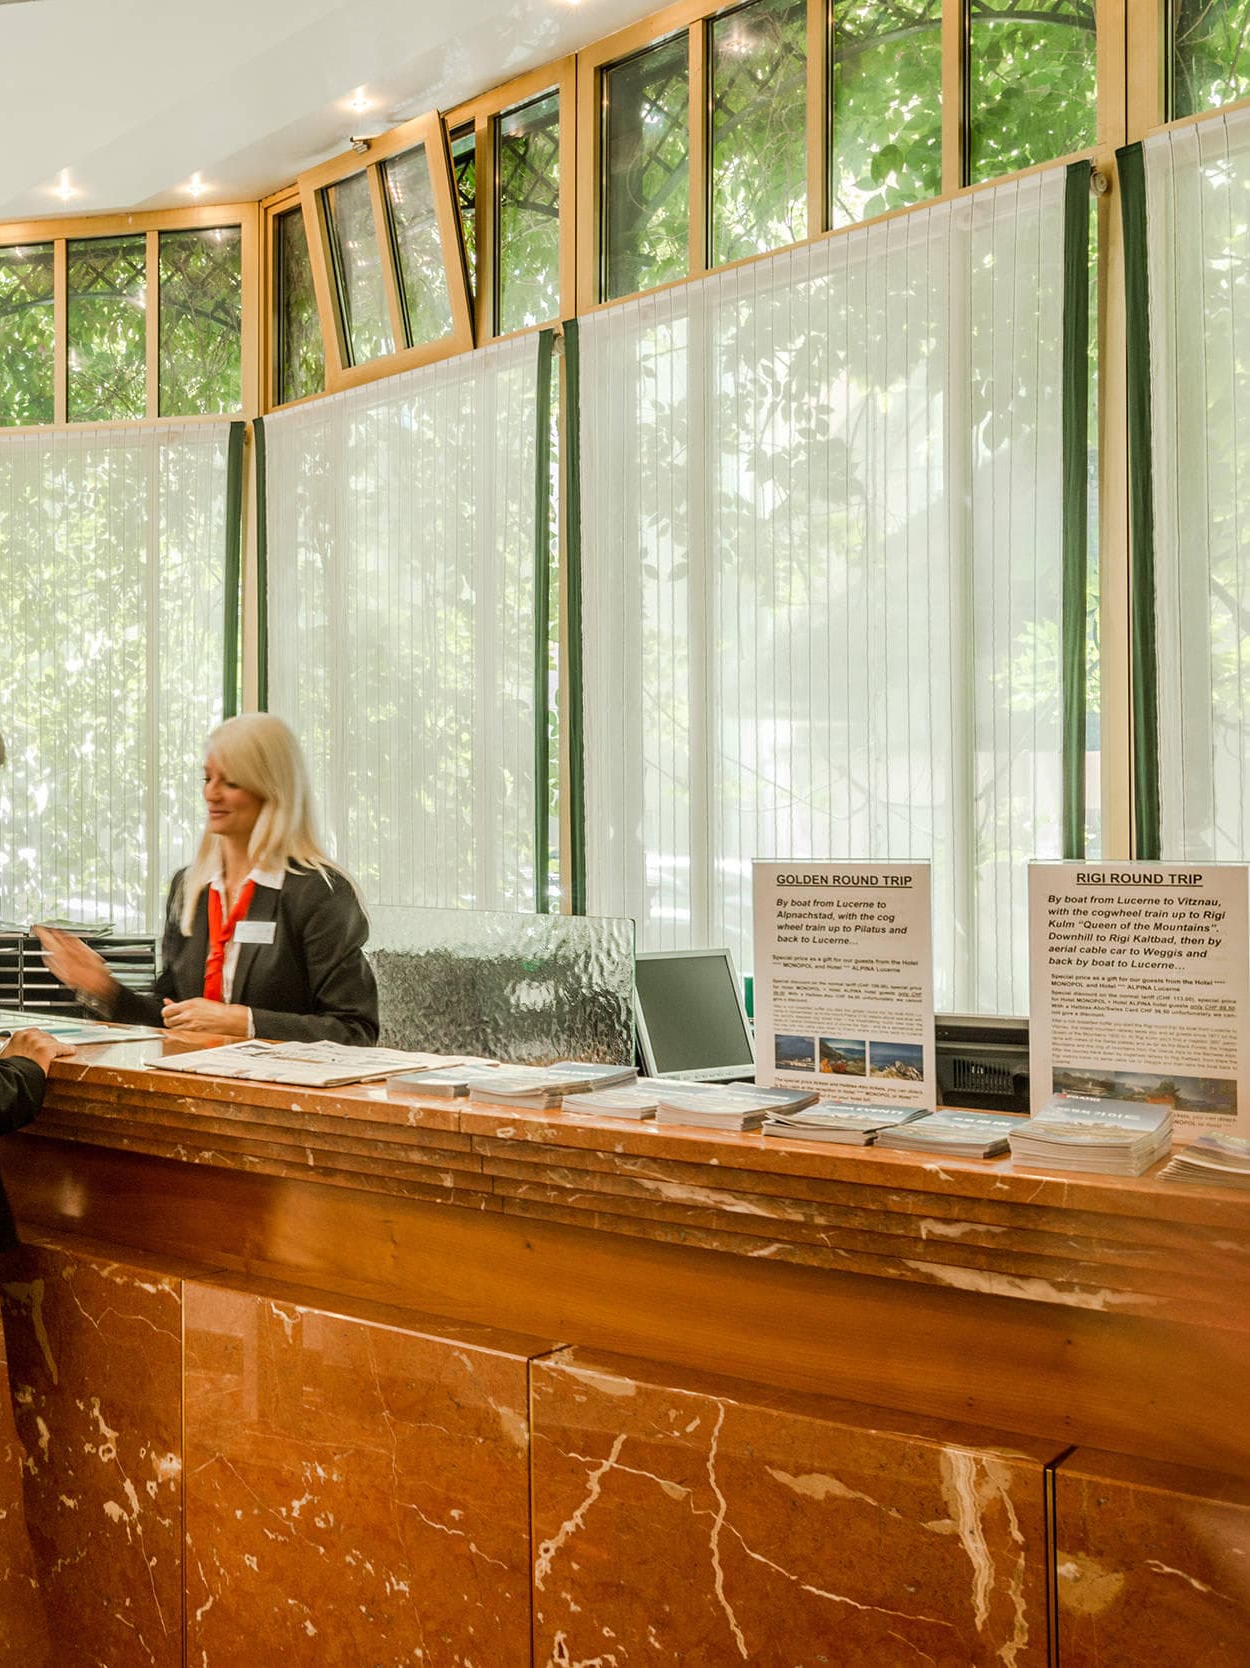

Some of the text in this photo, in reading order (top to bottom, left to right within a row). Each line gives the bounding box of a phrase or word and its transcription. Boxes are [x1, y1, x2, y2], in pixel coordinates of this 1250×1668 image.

[777, 875, 912, 885] GOLDEN ROUND TRIP
[1076, 873, 1202, 884] RIGI ROUND TRIP
[776, 899, 788, 908] By
[813, 899, 834, 907] from
[1048, 895, 1061, 904] By
[1090, 896, 1114, 904] from
[1178, 897, 1221, 907] Vitznau,
[777, 911, 835, 920] Alpnachstad,
[838, 912, 857, 920] with
[1092, 909, 1141, 918] cogwheel
[1172, 912, 1186, 920] up
[1203, 911, 1225, 921] Rigi
[854, 925, 886, 933] Pilatus
[889, 926, 907, 934] and
[1048, 920, 1075, 928] Kulm
[1133, 922, 1150, 930] the
[1049, 932, 1093, 941] Downhill
[1109, 934, 1130, 944] Rigi
[1133, 935, 1176, 944] Kaltbad,
[1208, 937, 1221, 947] by
[1079, 946, 1107, 954] cable
[1143, 948, 1182, 958] Weggis
[1186, 950, 1207, 958] and
[1049, 957, 1073, 965] back
[1076, 958, 1088, 967] by
[1092, 959, 1114, 967] boat
